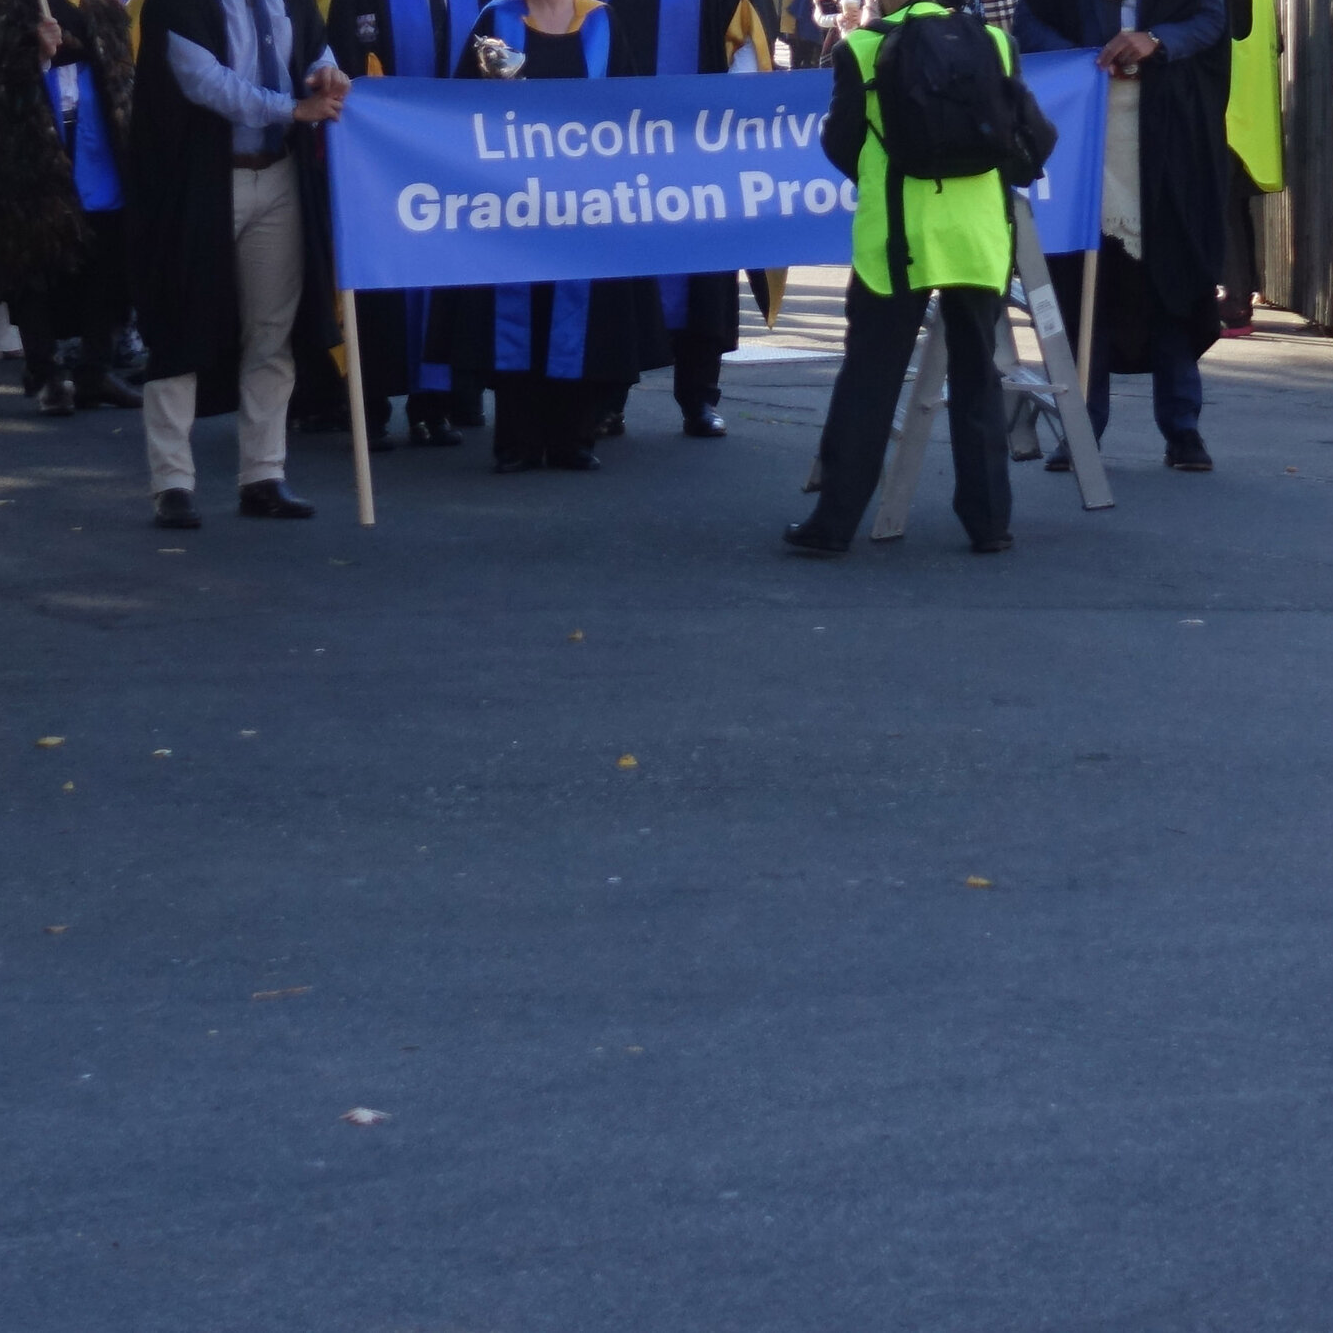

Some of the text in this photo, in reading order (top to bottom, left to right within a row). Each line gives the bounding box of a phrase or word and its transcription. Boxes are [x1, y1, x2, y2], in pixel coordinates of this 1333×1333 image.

[473, 105, 827, 161] Lincoln Univ
[397, 172, 726, 232] Graduation
